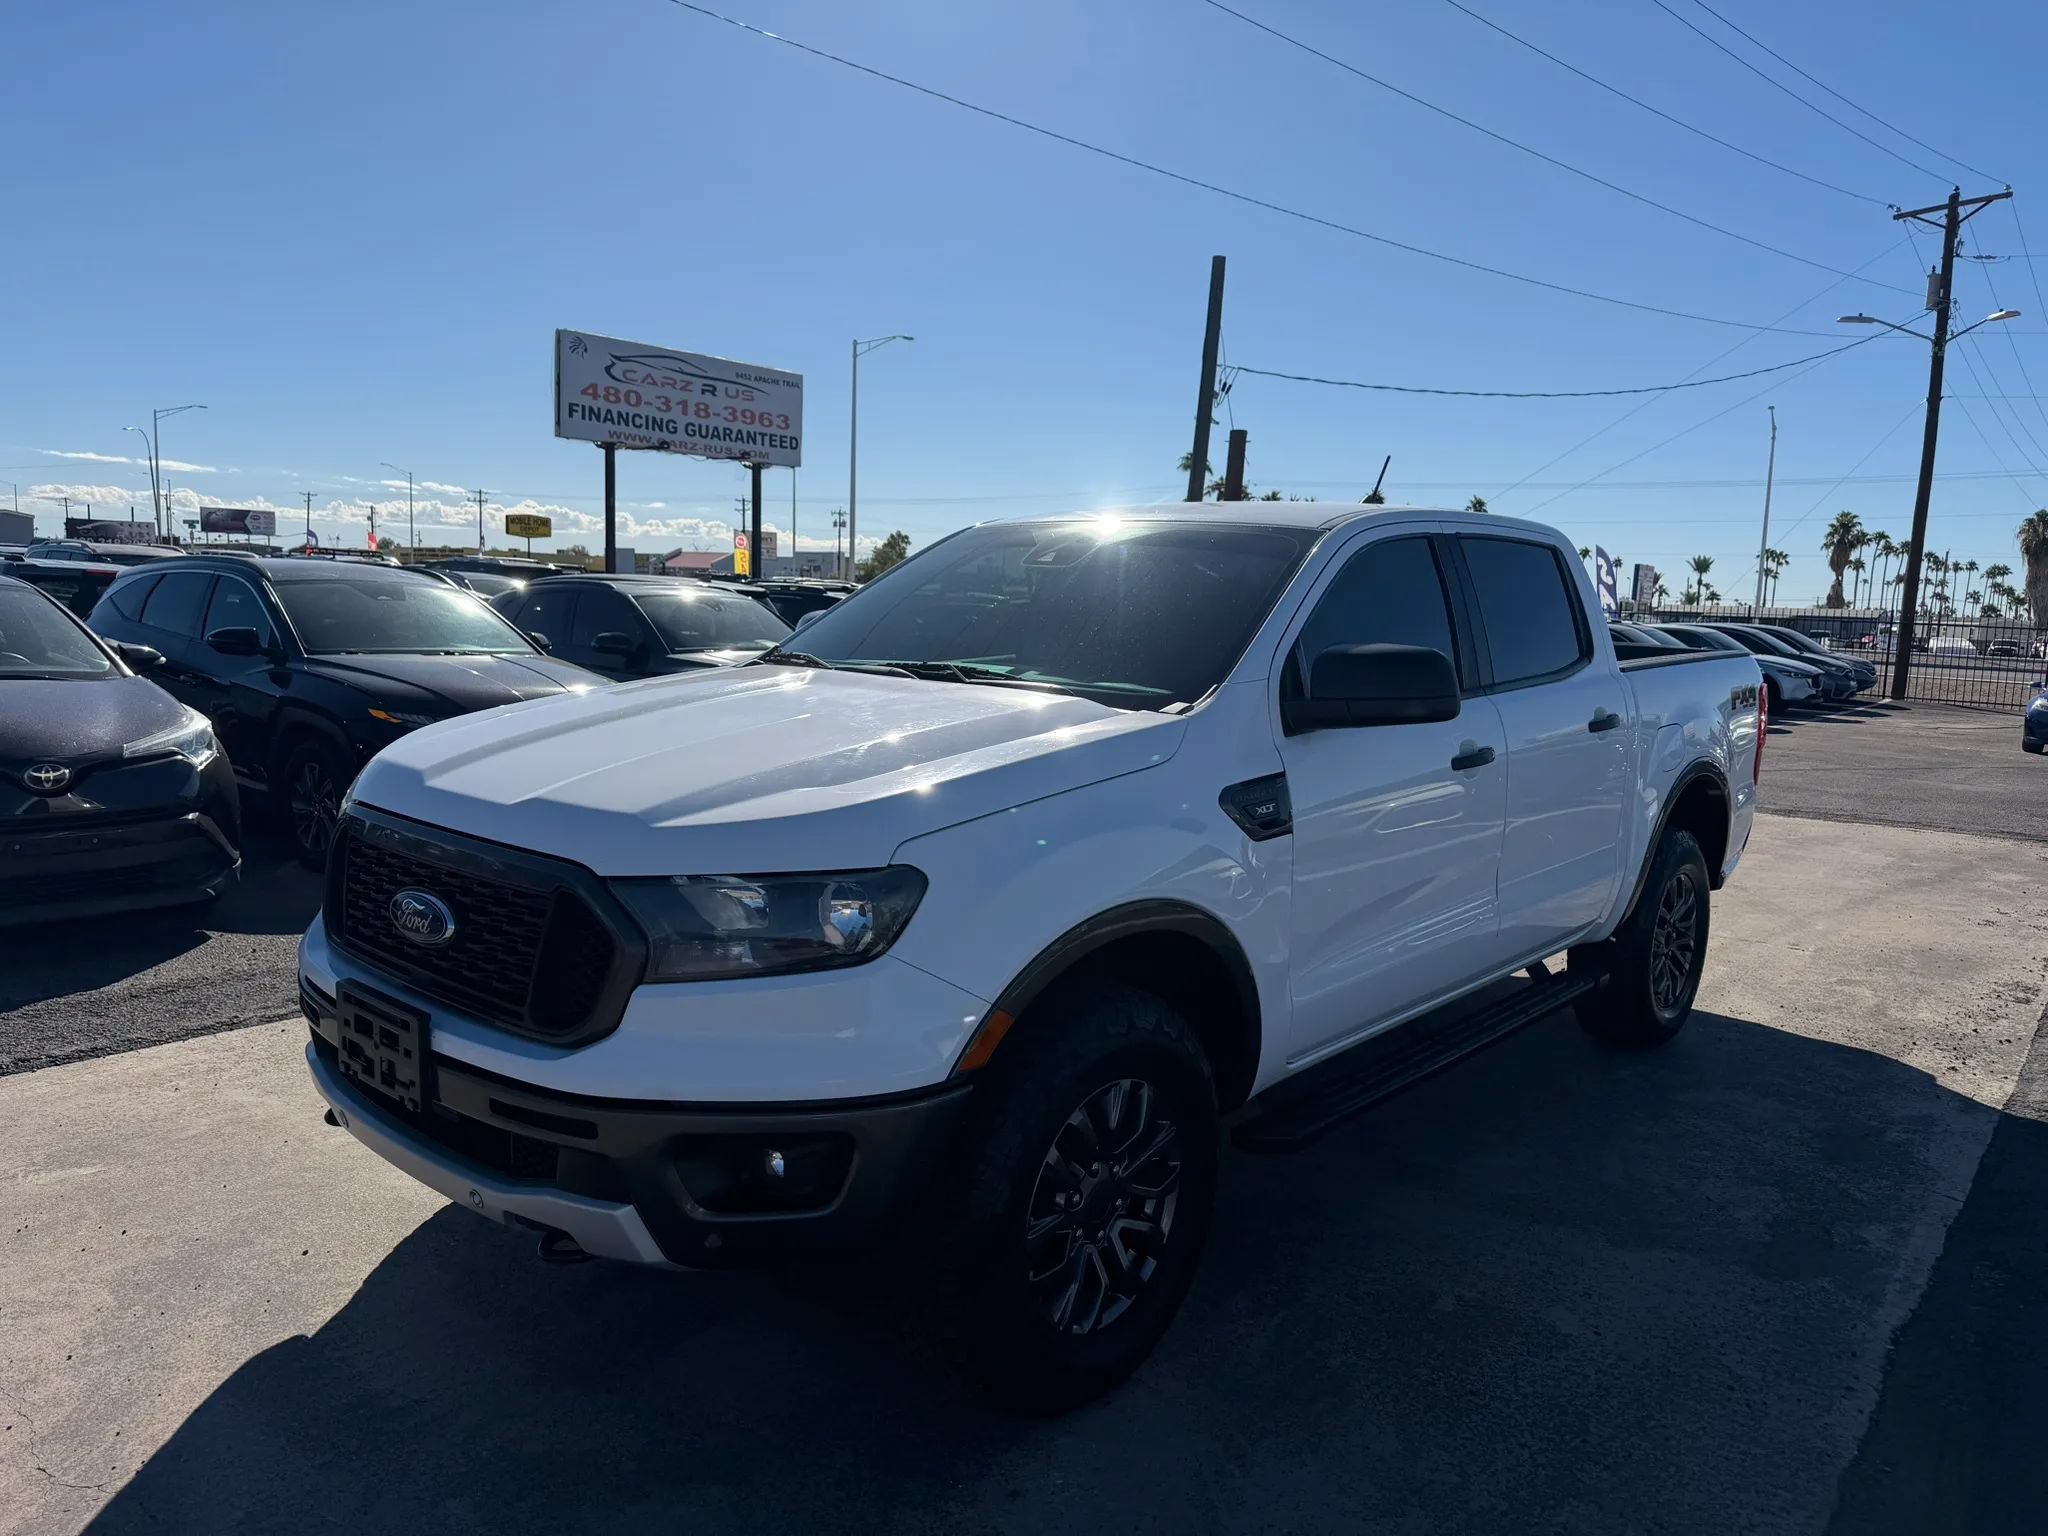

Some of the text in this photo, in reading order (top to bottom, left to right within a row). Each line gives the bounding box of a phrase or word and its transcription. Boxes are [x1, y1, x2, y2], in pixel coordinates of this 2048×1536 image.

[621, 368, 757, 402] CARZ R US
[754, 375, 781, 386] APACHE
[782, 379, 801, 390] TRAIL
[580, 382, 791, 432] 480-318-3963
[568, 402, 800, 451] FINANCING GUARANTEED
[1255, 803, 1276, 816] XLT
[397, 898, 434, 935] Ford
